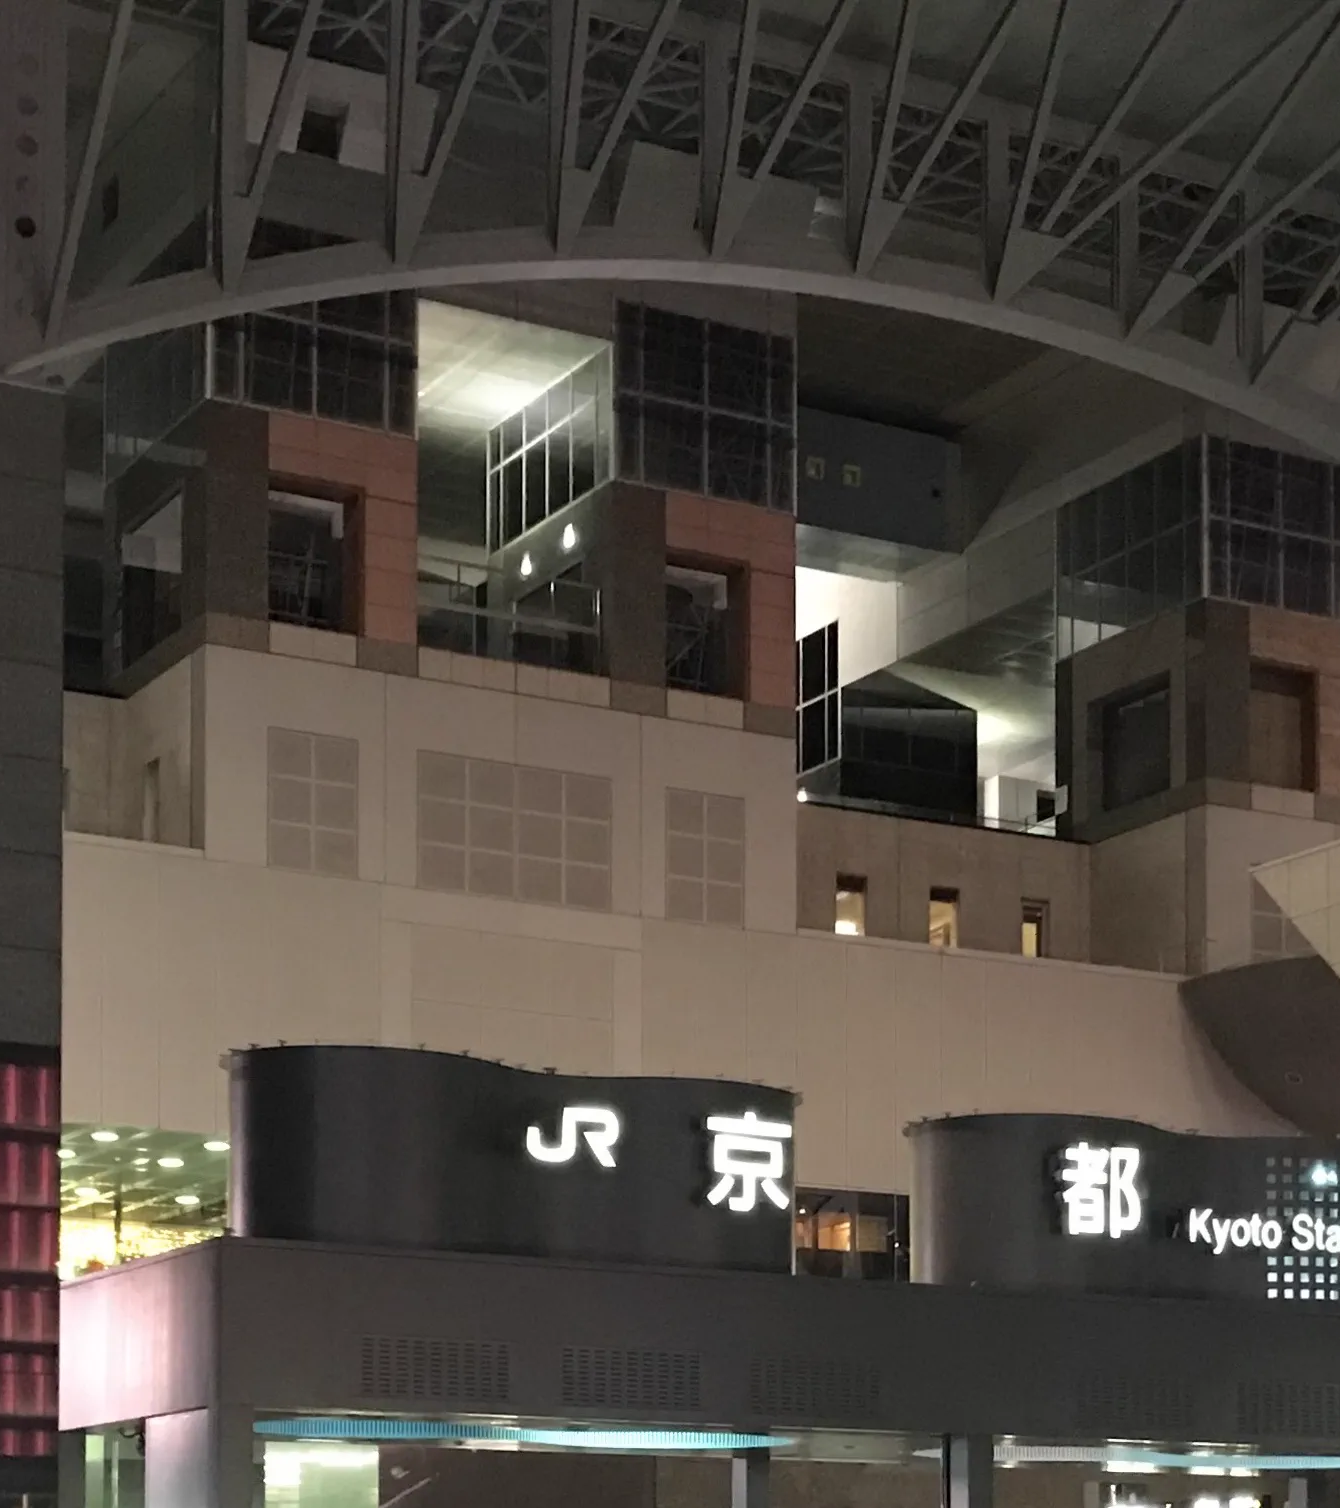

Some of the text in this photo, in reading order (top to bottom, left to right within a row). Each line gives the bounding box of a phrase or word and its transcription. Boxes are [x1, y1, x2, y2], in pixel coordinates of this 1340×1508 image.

[525, 1104, 621, 1168] JR
[706, 1110, 792, 1213] 京
[1061, 1141, 1143, 1240] 都
[1188, 1207, 1283, 1255] Kyoto
